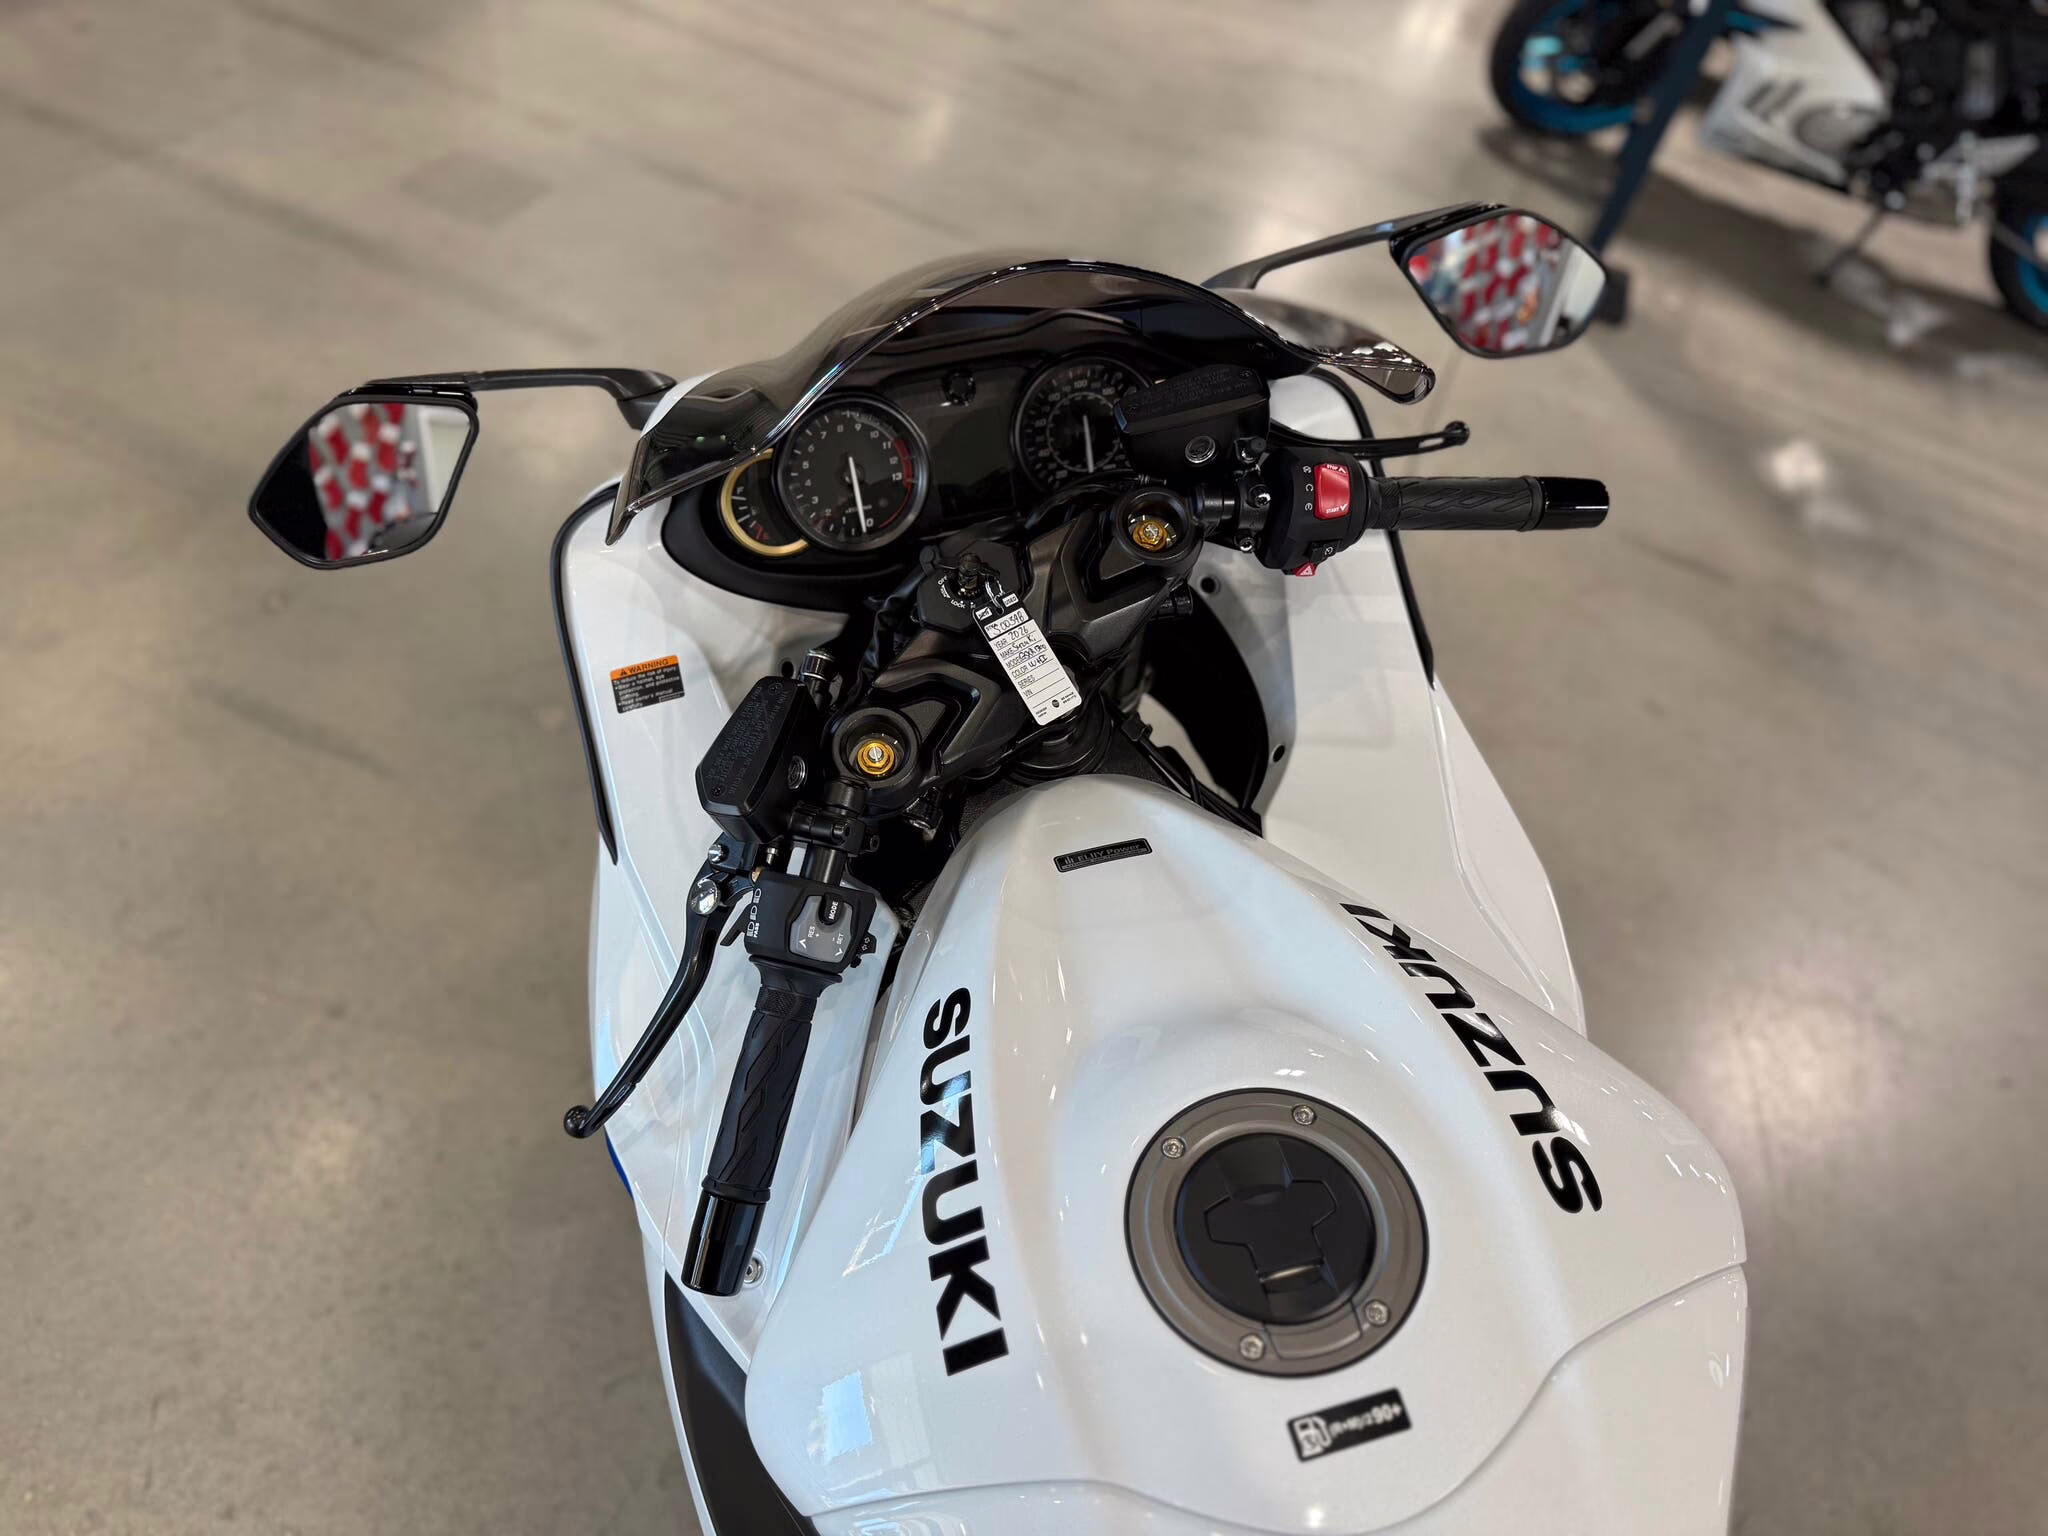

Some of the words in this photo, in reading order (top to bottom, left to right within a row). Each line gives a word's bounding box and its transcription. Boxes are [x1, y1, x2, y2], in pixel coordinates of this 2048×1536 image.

[883, 441, 892, 449] 11
[804, 479, 811, 487] 4
[892, 473, 902, 481] 13
[951, 599, 966, 609] LOCK
[630, 659, 669, 673] WARNING
[1012, 665, 1028, 678] COLOR
[1018, 674, 1036, 689] SERIES
[1106, 844, 1140, 856] Power
[828, 901, 839, 920] MODE
[808, 925, 816, 938] RES
[836, 933, 845, 945] SET
[1339, 902, 1602, 1213] SUZUKI
[920, 987, 1009, 1376] SUZUKI
